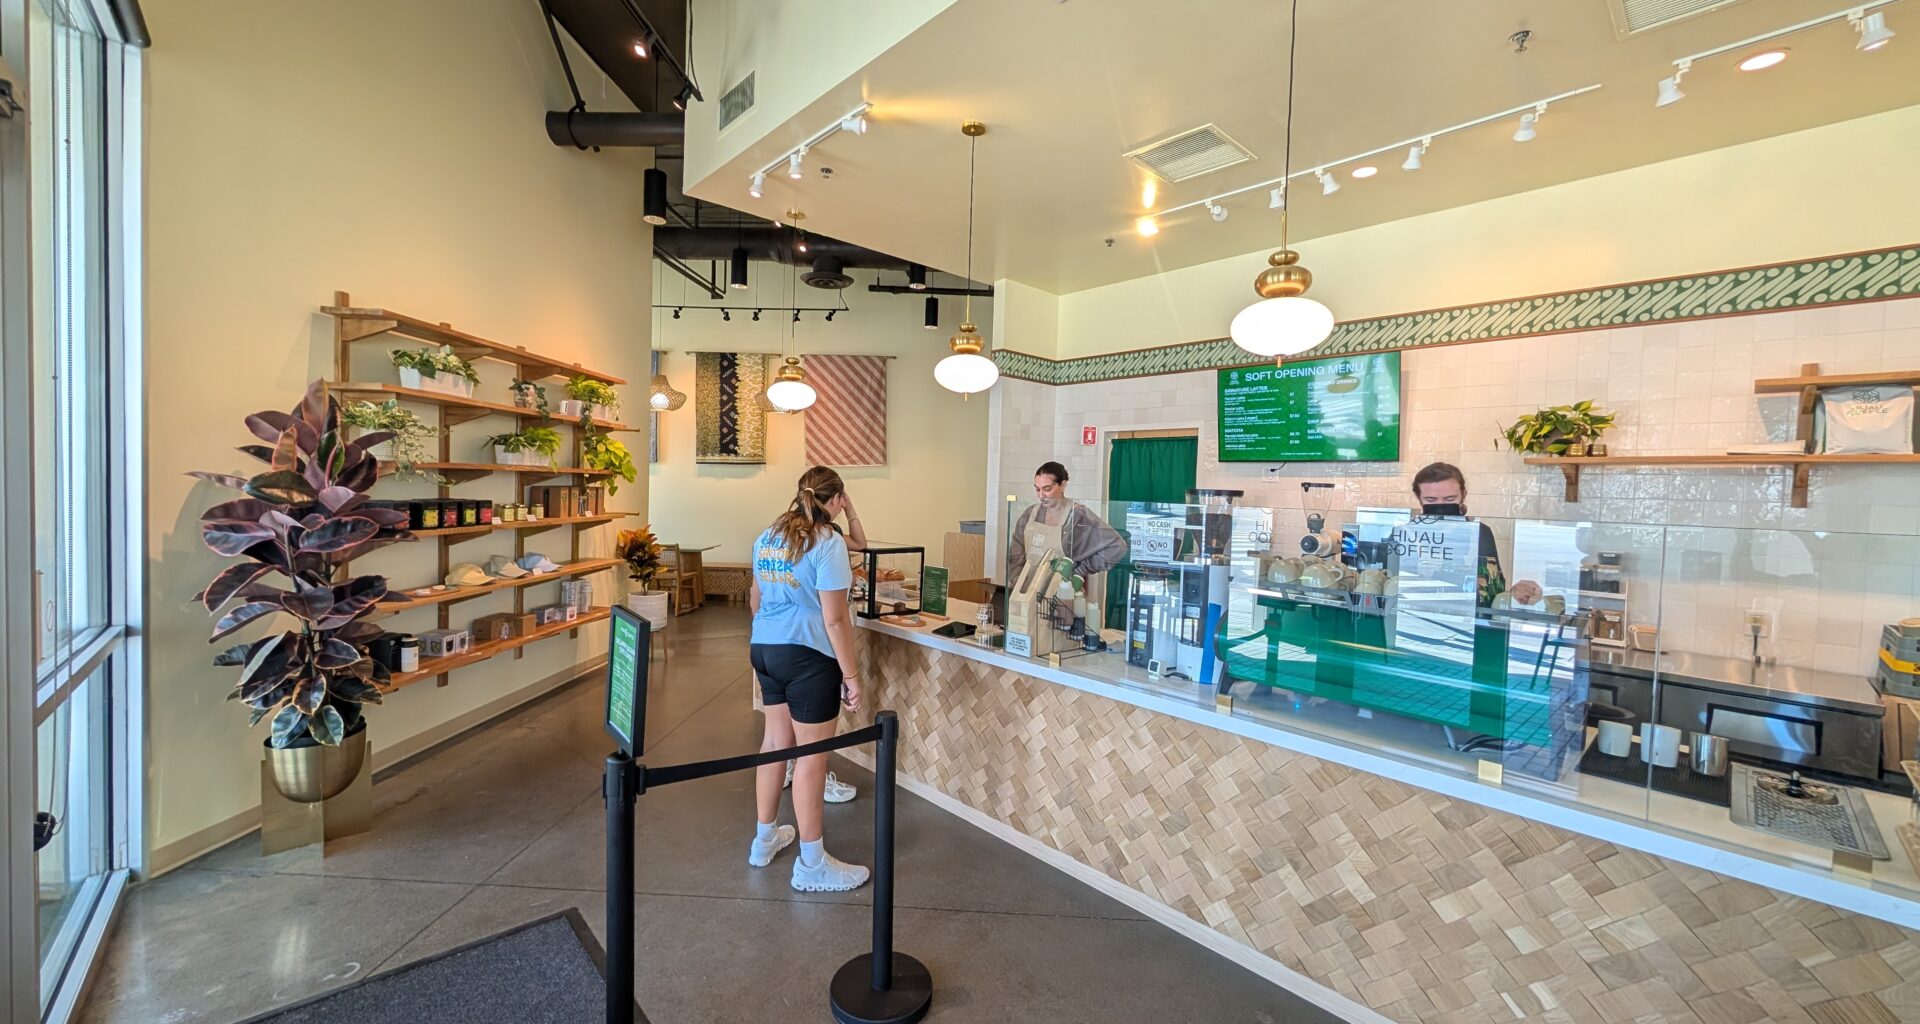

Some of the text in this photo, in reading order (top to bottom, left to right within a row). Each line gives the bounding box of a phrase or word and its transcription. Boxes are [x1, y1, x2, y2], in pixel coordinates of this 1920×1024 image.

[1245, 371, 1272, 382] SOFT
[1274, 366, 1324, 378] OPENING
[1328, 363, 1364, 374] MENU
[1392, 530, 1444, 545] HIJAU
[1385, 544, 1454, 560] COFFEE
